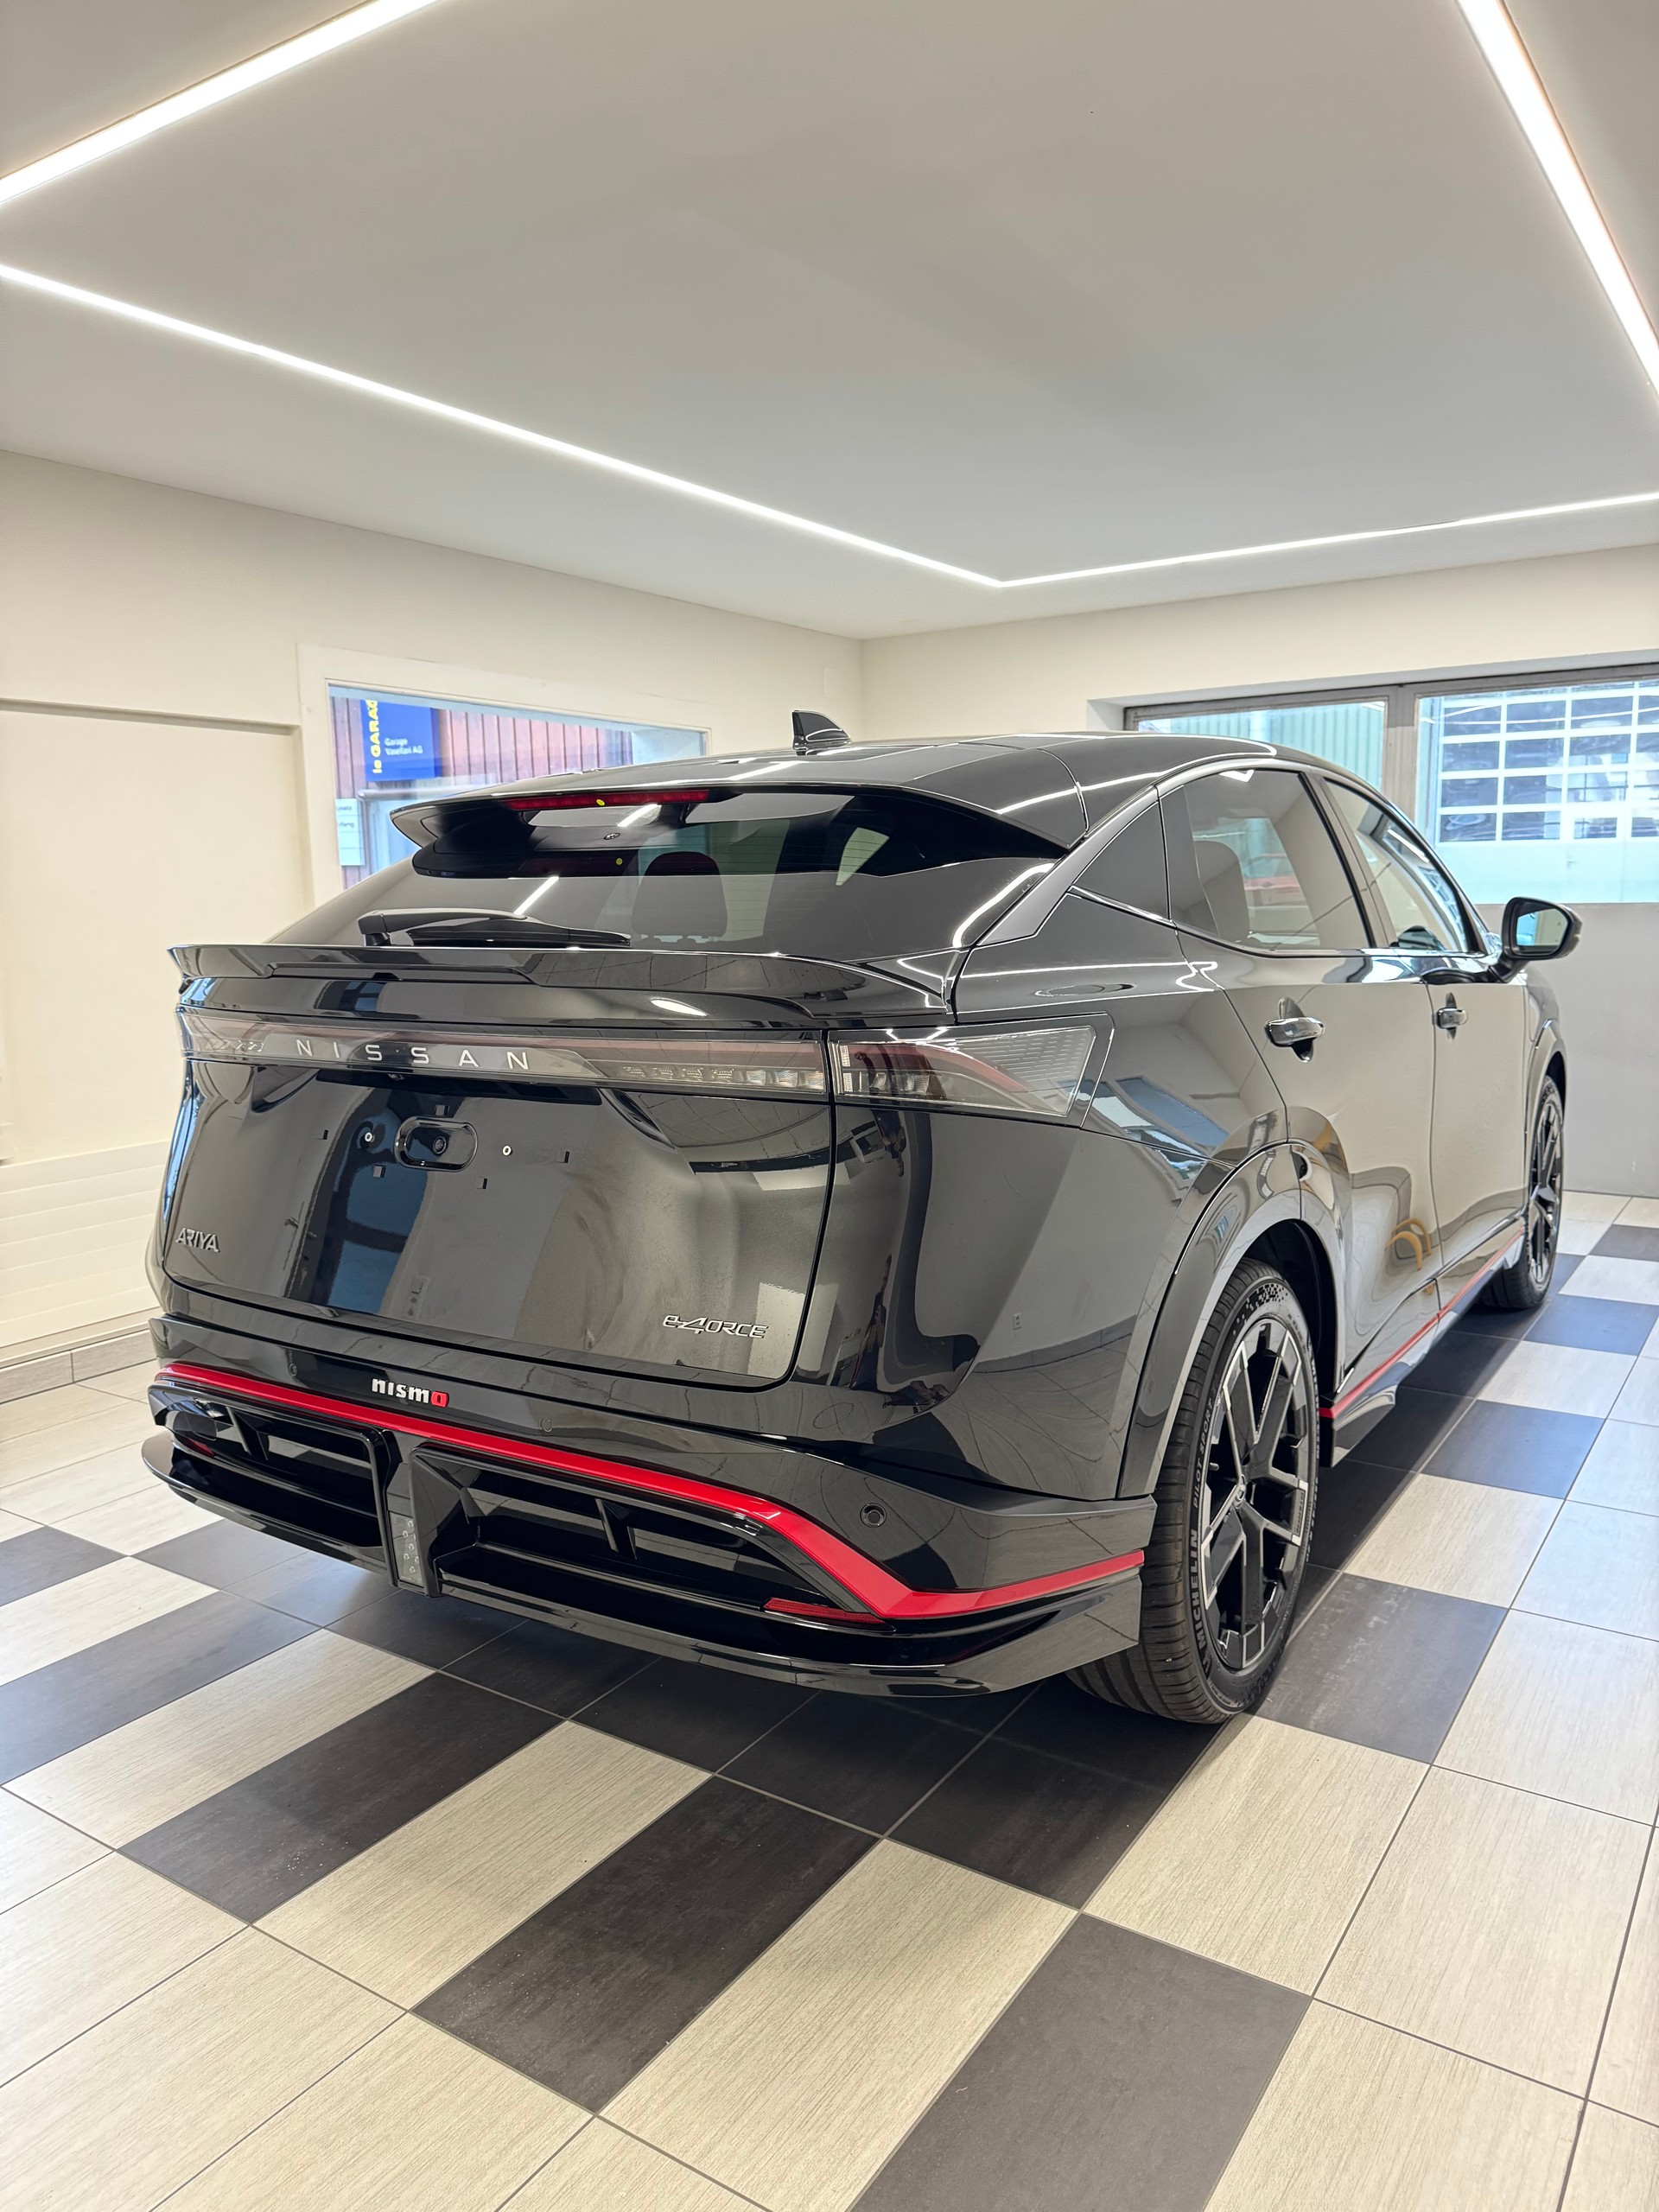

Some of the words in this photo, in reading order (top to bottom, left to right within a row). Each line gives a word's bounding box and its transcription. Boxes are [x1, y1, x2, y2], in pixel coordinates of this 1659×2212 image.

[385, 737, 408, 747] Garage
[296, 1039, 529, 1070] NISSAN
[175, 1228, 220, 1252] ARIYA
[1200, 1397, 1213, 1454] SPORT
[1192, 1458, 1202, 1509] PILOT
[1191, 1529, 1207, 1650] MICHELIN
